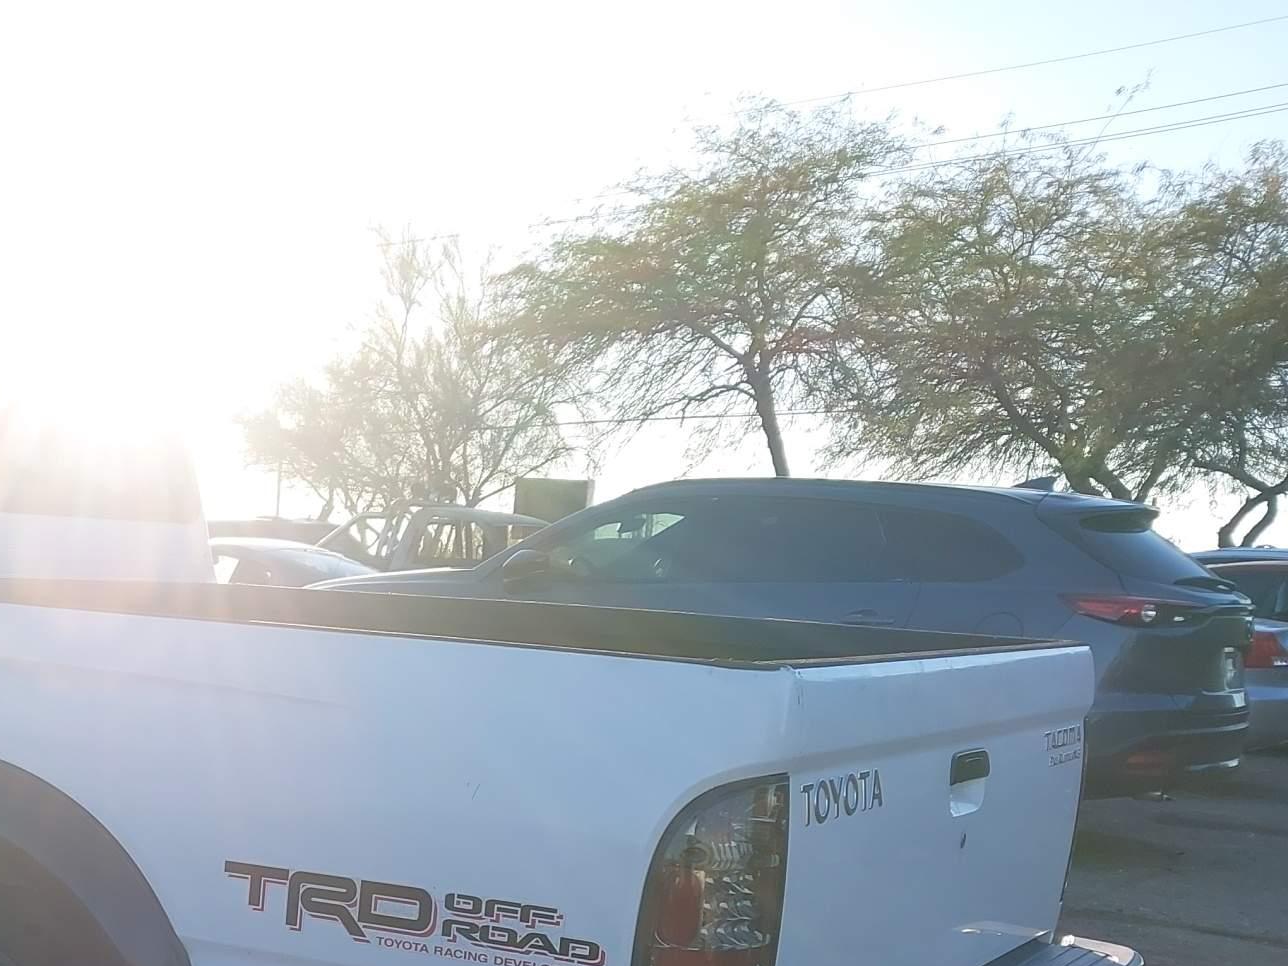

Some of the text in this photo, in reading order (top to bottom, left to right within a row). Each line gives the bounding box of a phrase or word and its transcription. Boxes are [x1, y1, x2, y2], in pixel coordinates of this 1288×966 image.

[1043, 723, 1081, 752] TACOMA
[800, 768, 883, 828] TOYOTA
[224, 860, 437, 944] TRD
[444, 892, 564, 929] OFF
[376, 936, 429, 955] TOYOTA
[434, 945, 488, 964] RACING
